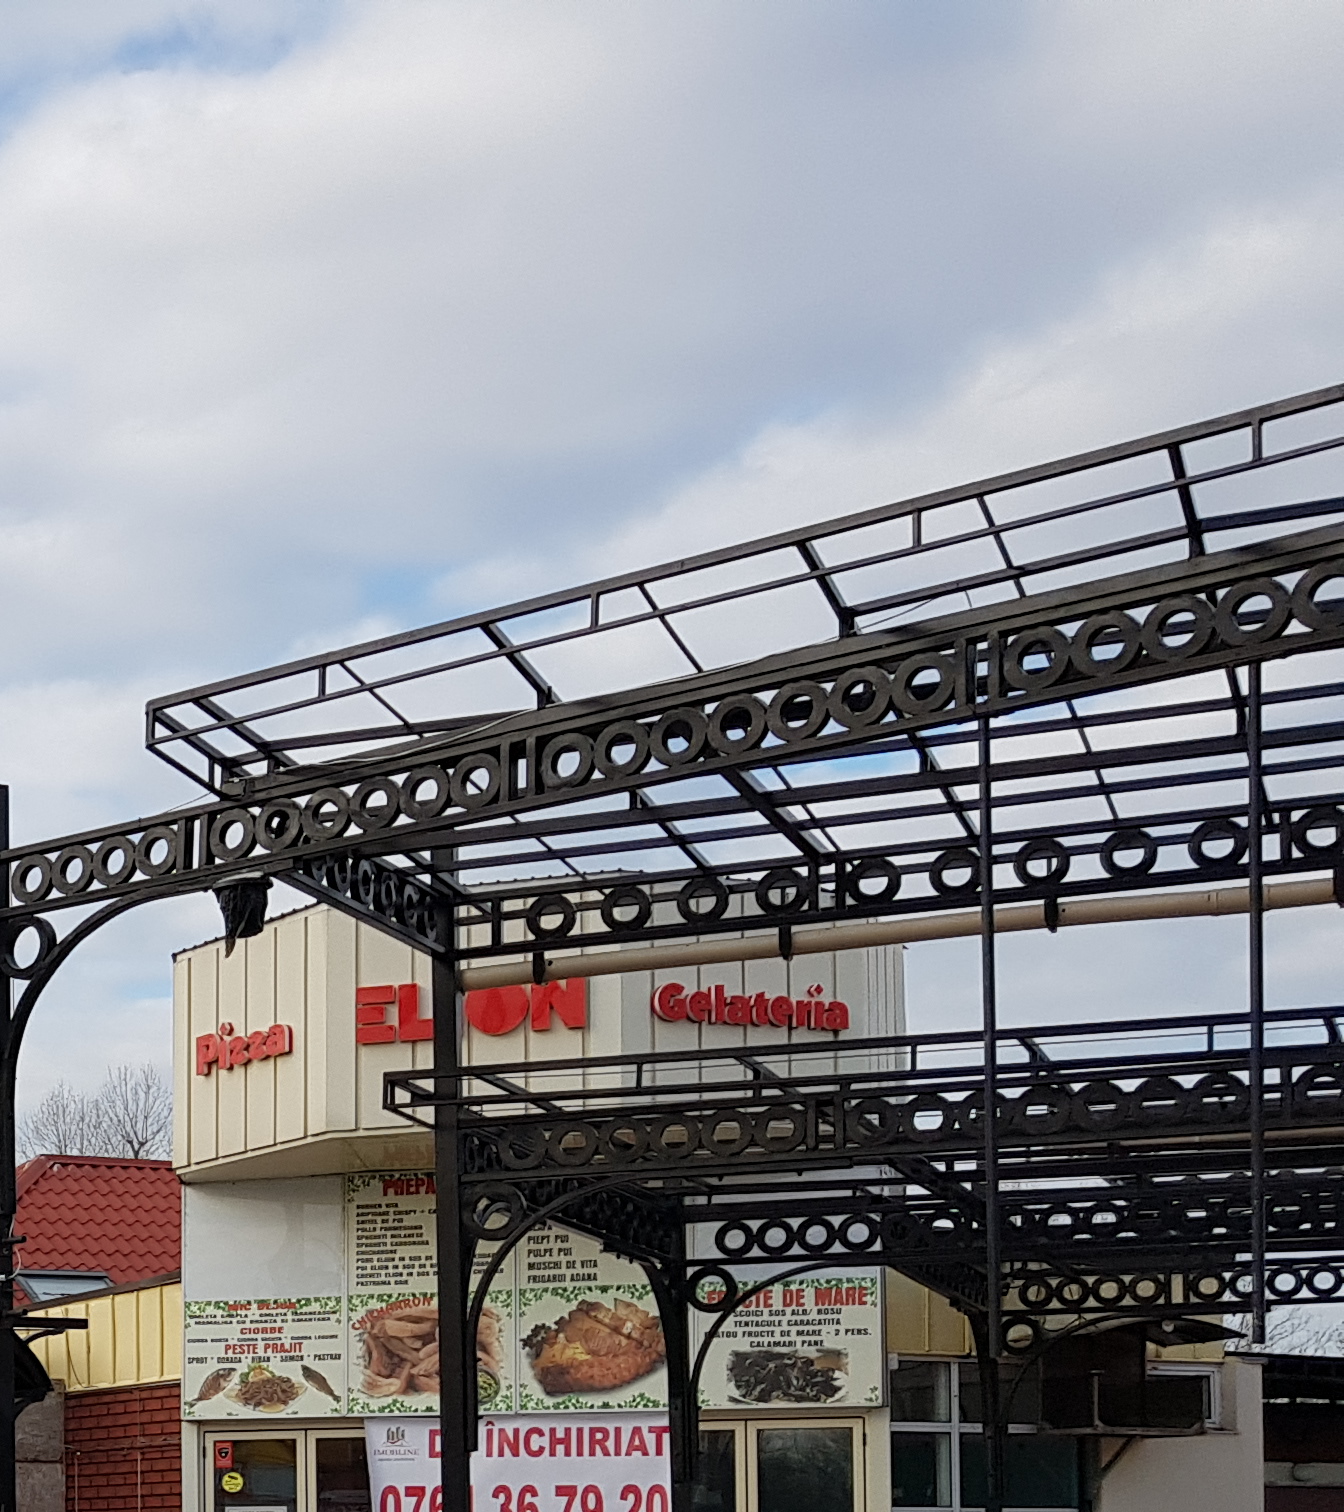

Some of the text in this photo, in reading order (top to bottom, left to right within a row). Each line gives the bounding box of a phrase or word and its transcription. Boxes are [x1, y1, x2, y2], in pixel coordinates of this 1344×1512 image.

[652, 983, 850, 1032] Gelateria
[196, 1022, 293, 1076] Pizza
[554, 1234, 569, 1243] PUI
[566, 1260, 577, 1269] DE
[580, 1259, 598, 1269] VITA
[782, 1288, 805, 1307] DE
[814, 1286, 868, 1306] MARE
[768, 1309, 787, 1317] SOS
[705, 1331, 738, 1339] PATOU
[225, 1342, 303, 1355] PESTE PRAJIT
[485, 1421, 670, 1458] ÎNCHIRIAT
